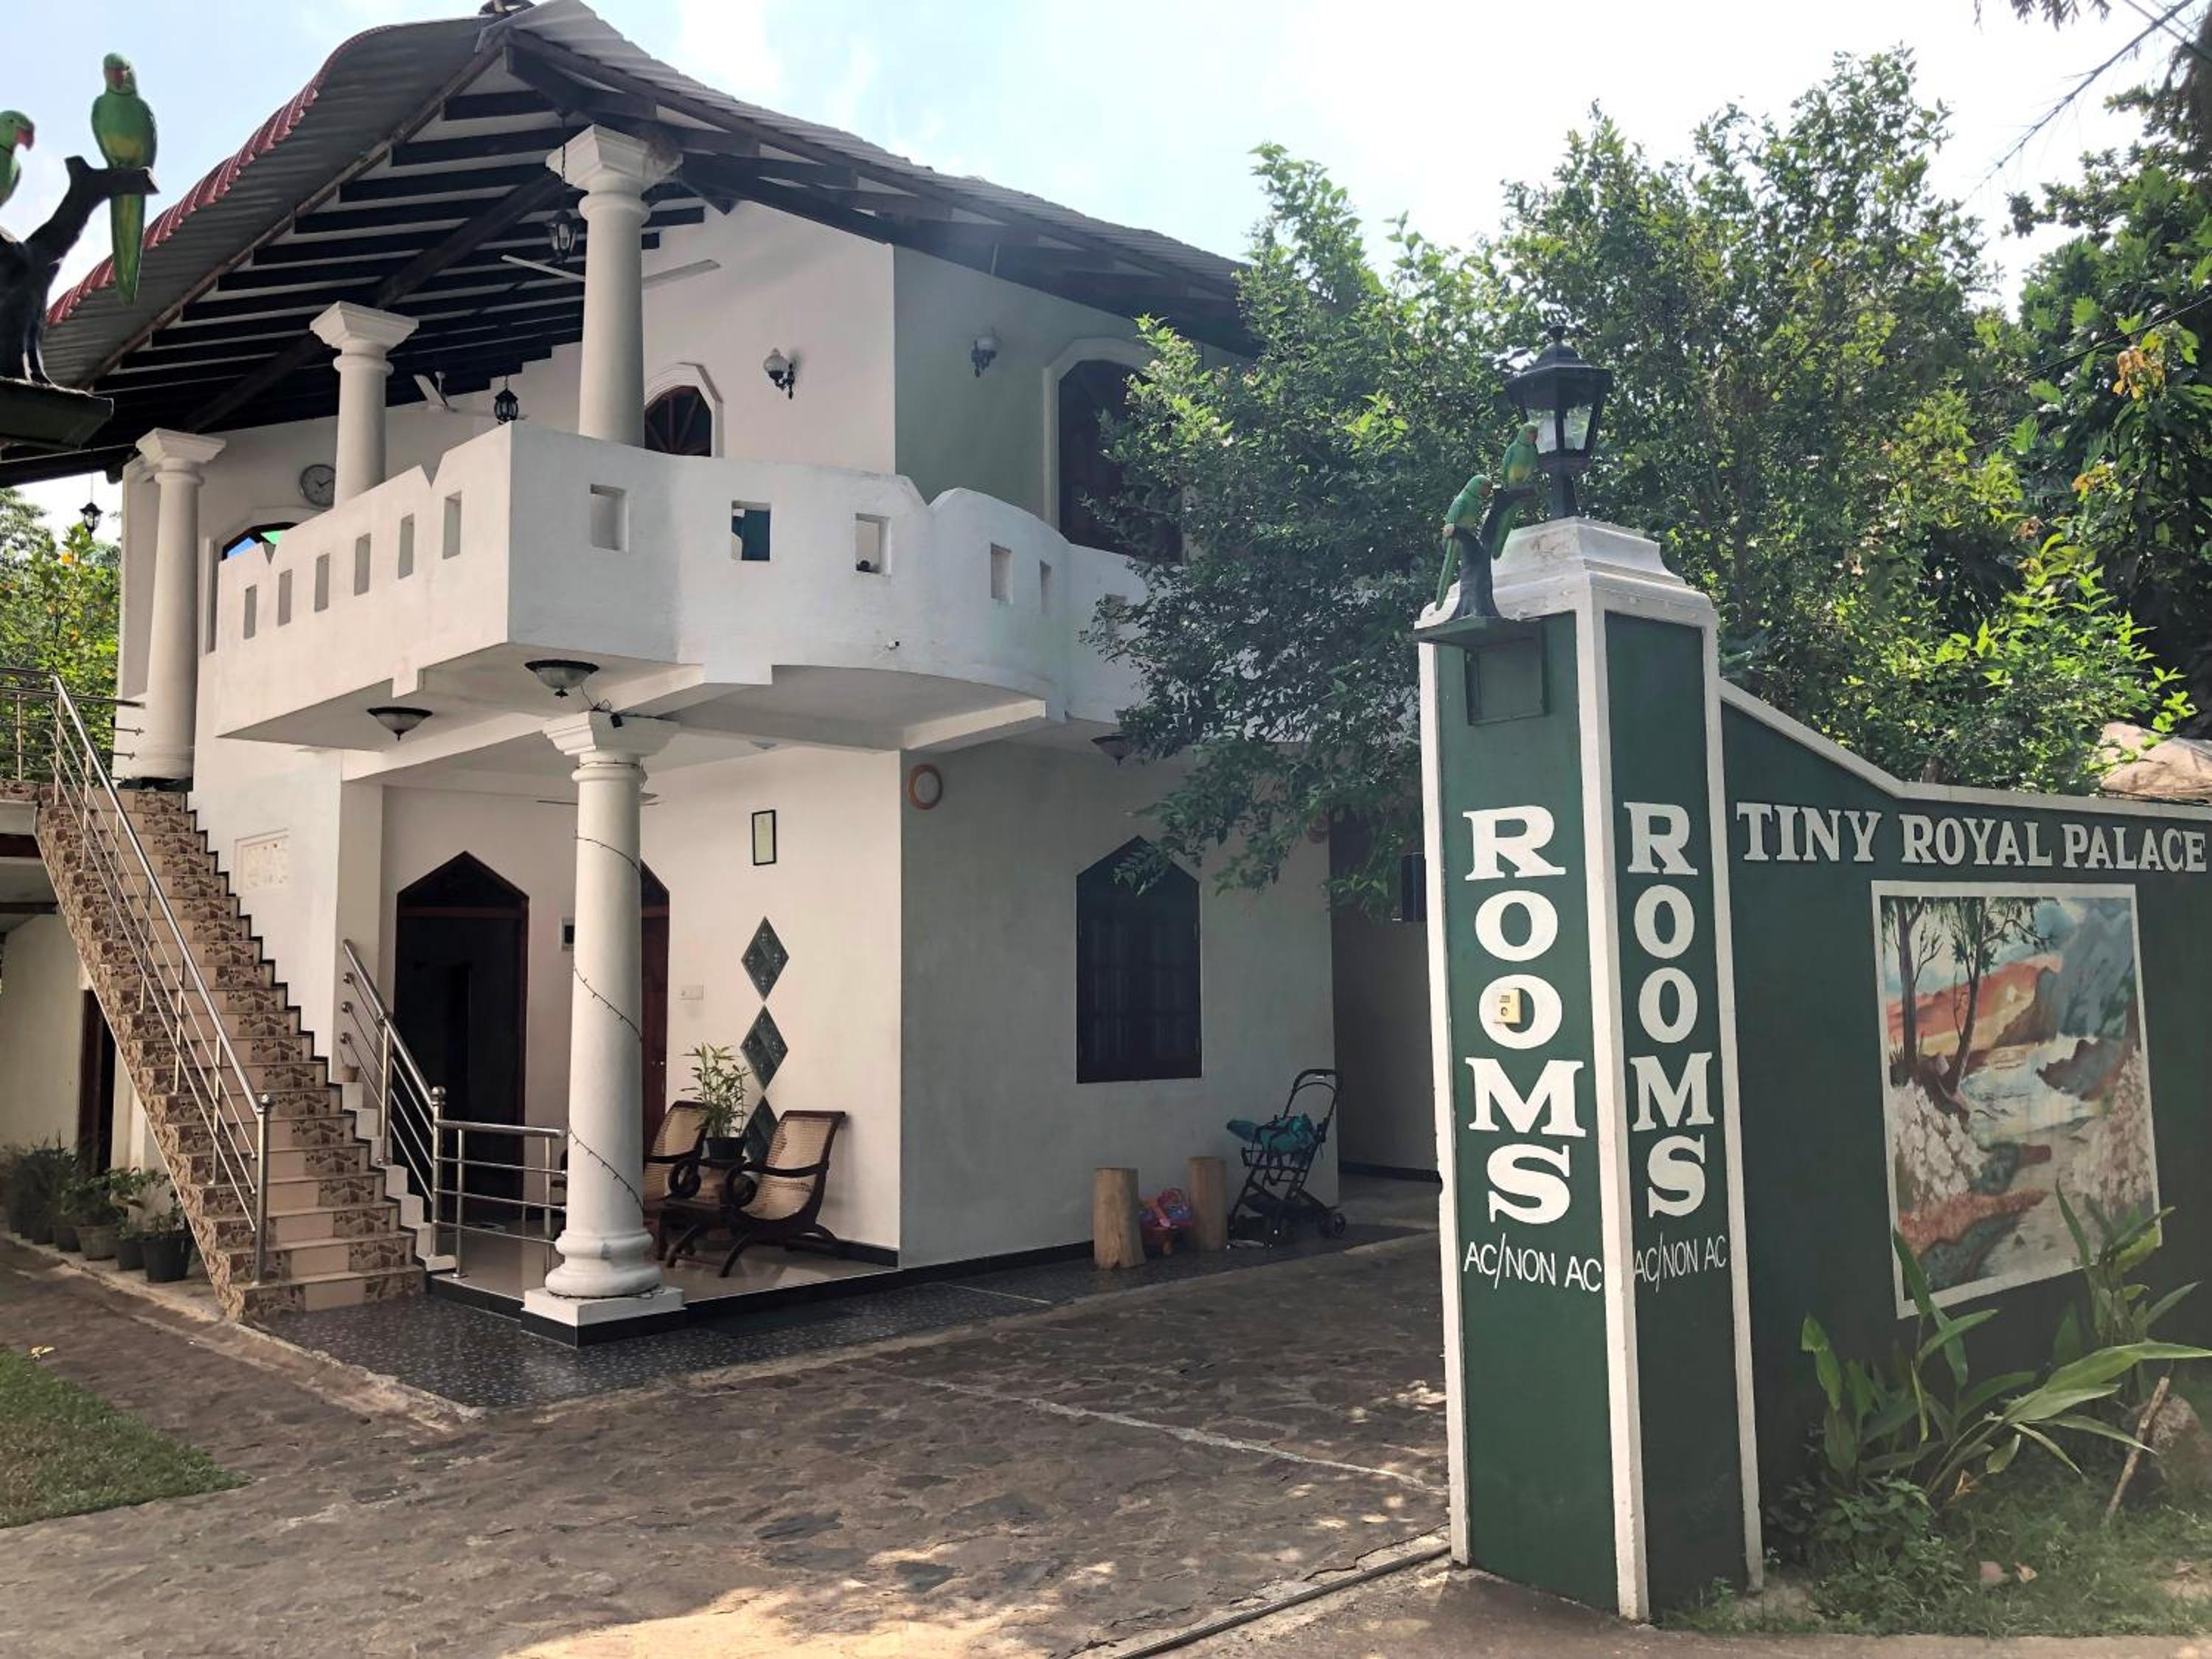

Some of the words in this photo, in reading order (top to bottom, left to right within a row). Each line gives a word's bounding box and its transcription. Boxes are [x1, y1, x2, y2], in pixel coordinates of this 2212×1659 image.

[1736, 801, 1883, 863] TINY
[1899, 813, 2053, 869] ROYAL
[2062, 822, 2208, 873] PALACE
[1462, 804, 1586, 1224] ROOMS
[1624, 801, 1714, 1217] ROOMS
[1464, 1233, 1557, 1290] AC/NON
[1565, 1256, 1602, 1293] AC
[1633, 1232, 1699, 1293] AC/NON
[1704, 1234, 1727, 1273] AC
